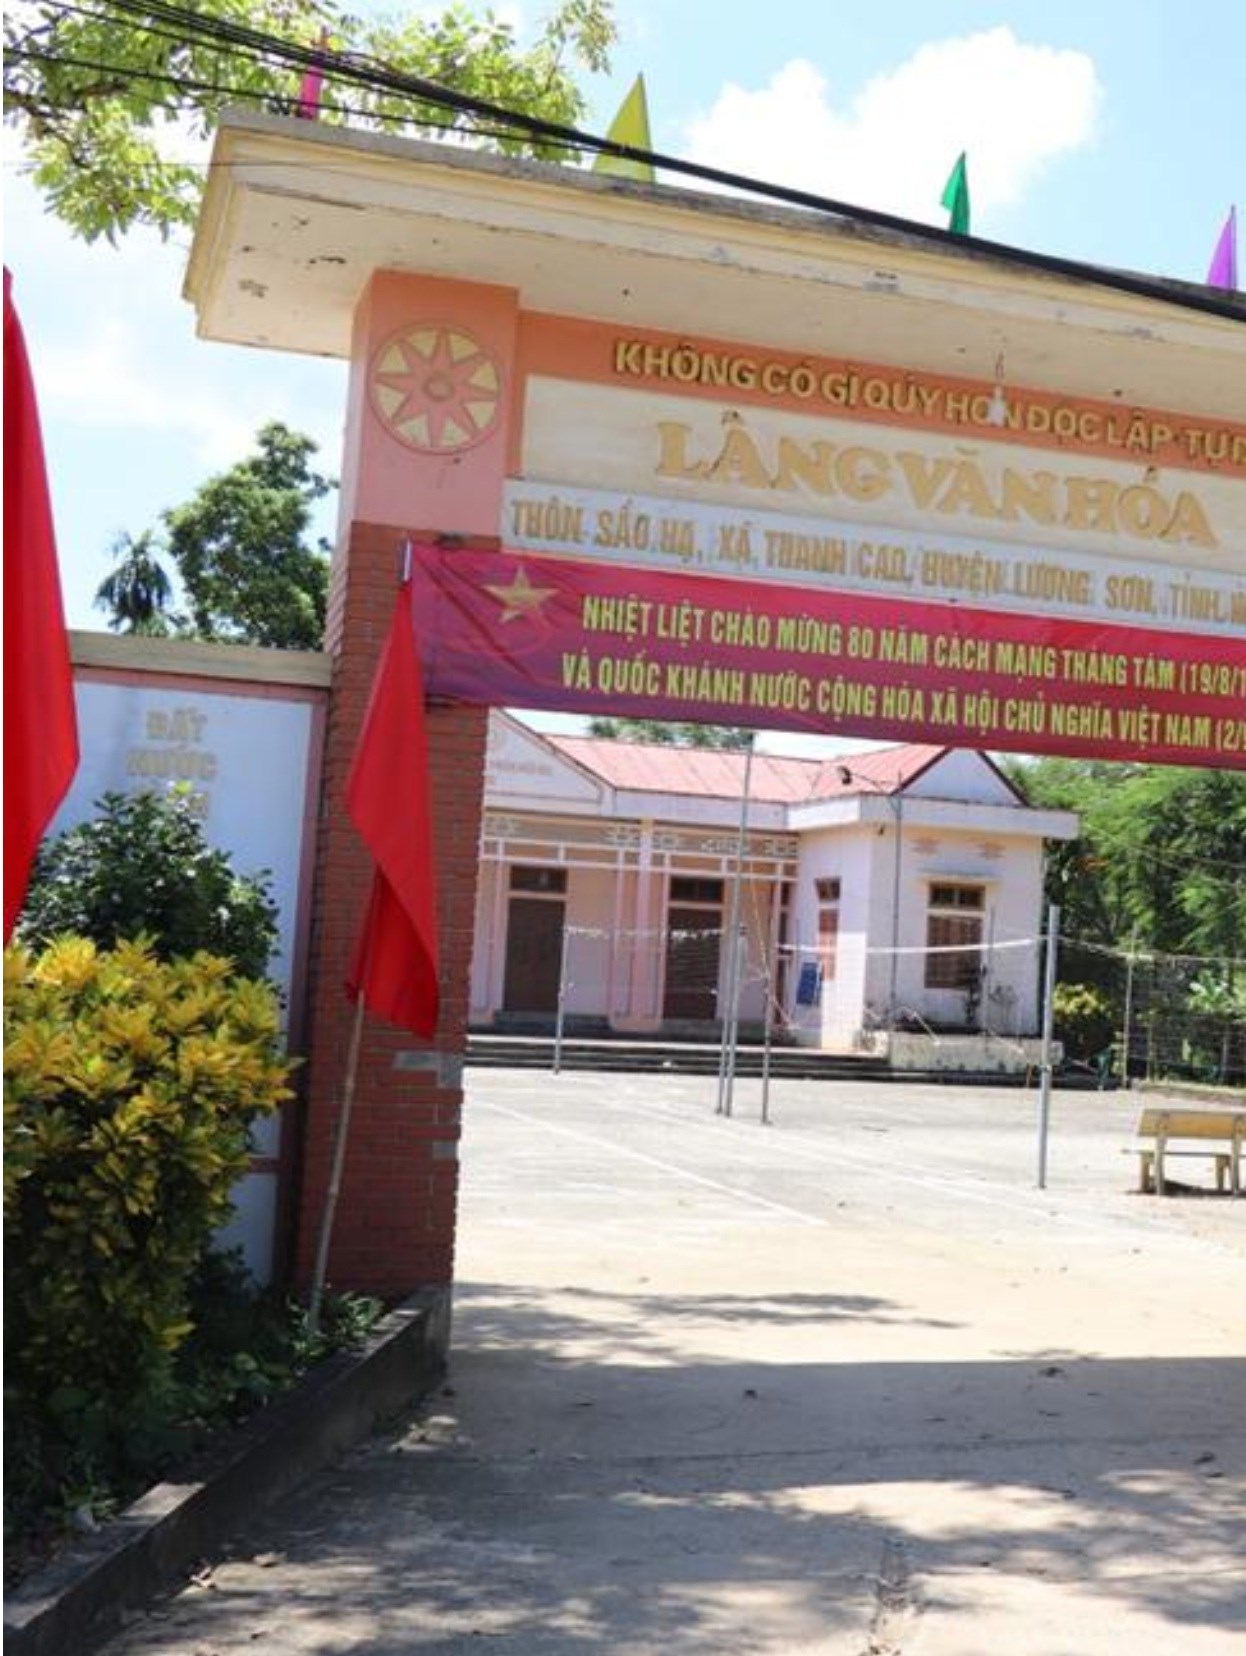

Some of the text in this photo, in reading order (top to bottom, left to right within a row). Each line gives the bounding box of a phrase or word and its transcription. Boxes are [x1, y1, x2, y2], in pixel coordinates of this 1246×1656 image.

[615, 341, 757, 389] KHÔNG
[762, 360, 817, 397] CÓ
[512, 496, 584, 543] THÔN
[763, 531, 846, 576] THANH
[897, 447, 1058, 525] VĂN
[1063, 467, 1219, 547] HÓA
[583, 593, 653, 643] NHIỆT
[657, 599, 705, 648] LIỆT
[711, 606, 772, 649] CHÀO
[776, 614, 842, 657] MỪNG
[846, 626, 874, 660] 80
[878, 626, 928, 666] NĂM
[933, 633, 991, 672] CÁCH
[995, 642, 1057, 684] MẠNG
[1063, 645, 1128, 688] THÁNG
[1133, 653, 1176, 691] TÁM
[562, 648, 592, 691] VÀ
[598, 649, 661, 696] QUỐC
[667, 660, 745, 706] KHÁNH
[750, 670, 811, 712] NƯỚC
[817, 675, 877, 723] CỘNG
[882, 680, 924, 722] HÓA
[929, 687, 957, 726] XÃ
[963, 690, 1000, 736] HỘI
[1004, 691, 1046, 734] CHỦ
[1051, 701, 1113, 741] NGHĨA
[1118, 705, 1161, 750] VIỆT
[1165, 713, 1211, 749] NAM
